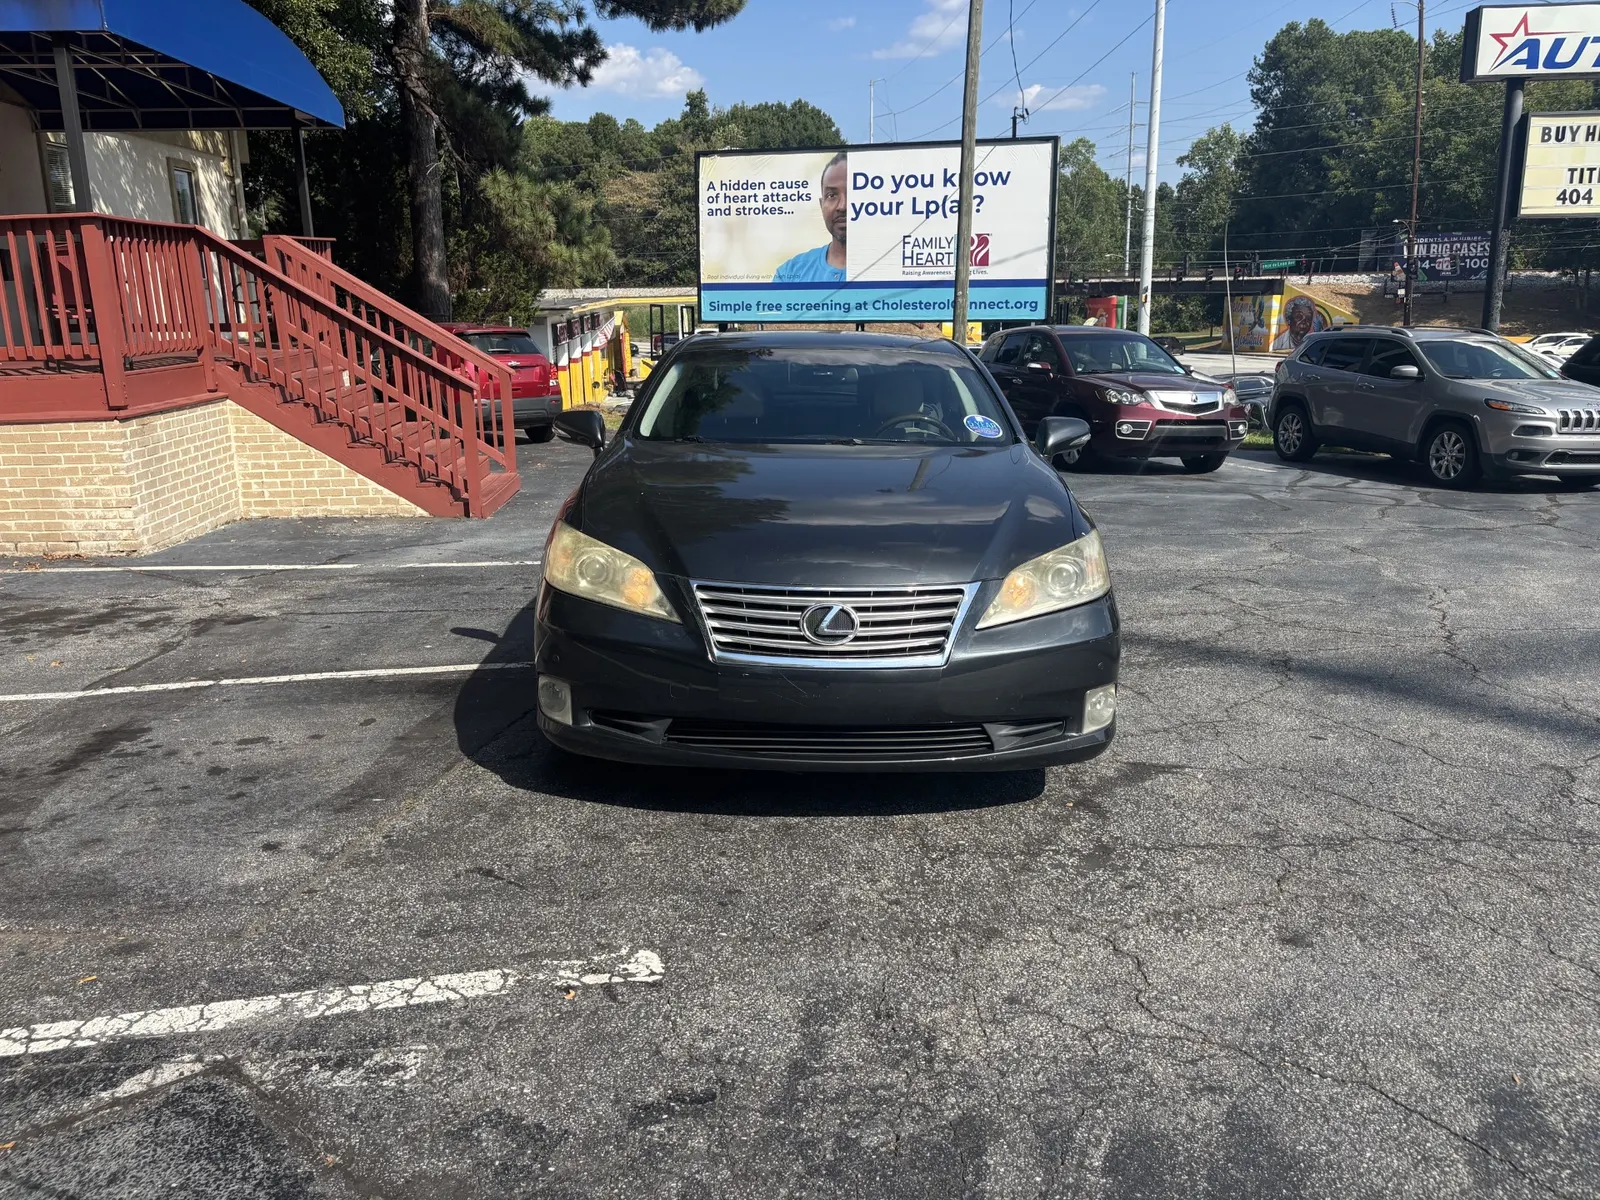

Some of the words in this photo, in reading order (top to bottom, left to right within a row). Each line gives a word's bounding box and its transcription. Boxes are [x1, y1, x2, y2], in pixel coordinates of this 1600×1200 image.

[1490, 37, 1600, 71] AU
[1540, 125, 1581, 143] BUY
[1585, 125, 1600, 142] H
[852, 172, 884, 190] Do
[890, 173, 934, 194] you
[943, 168, 1011, 188] kow
[1568, 168, 1600, 184] TIT
[706, 181, 716, 192] A
[720, 180, 766, 191] hidden
[770, 180, 809, 190] cause
[706, 193, 720, 204] of
[724, 193, 758, 204] heart
[762, 191, 812, 202] attacks
[1556, 188, 1593, 205] 404
[707, 206, 731, 216] and
[735, 204, 794, 216] strokes...
[850, 200, 904, 221] your
[912, 195, 984, 219] Lp(a?
[902, 234, 954, 250] FAMILY
[1430, 243, 1450, 258] BIG
[1453, 242, 1490, 256] CASES
[902, 250, 954, 266] HEART
[709, 300, 752, 314] Simple
[756, 300, 782, 312] free
[786, 300, 850, 313] screening
[855, 300, 868, 310] at
